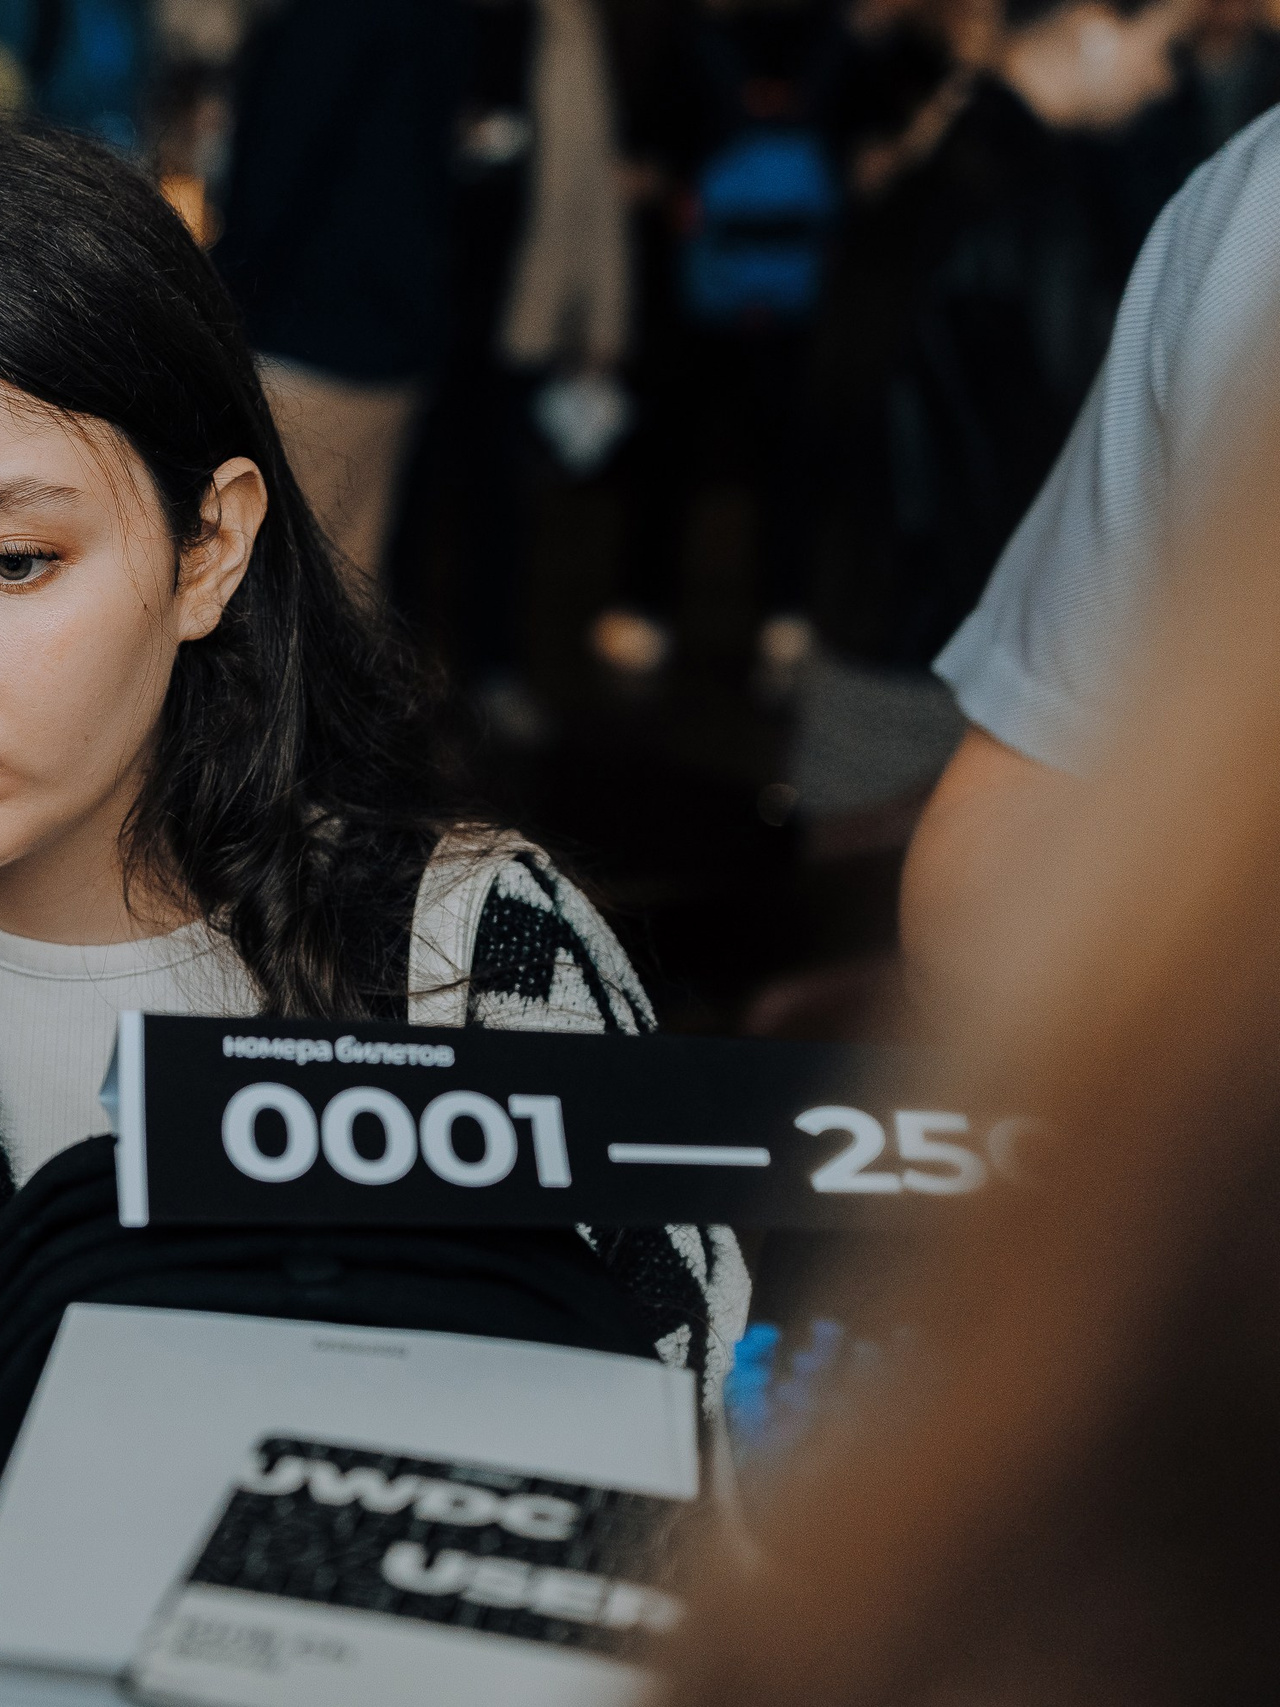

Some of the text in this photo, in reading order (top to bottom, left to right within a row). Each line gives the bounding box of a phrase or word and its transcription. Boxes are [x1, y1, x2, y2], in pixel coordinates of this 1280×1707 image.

[223, 1034, 455, 1067] номера билетов
[221, 1081, 572, 1188] 0001
[233, 1454, 579, 1541] UWDC
